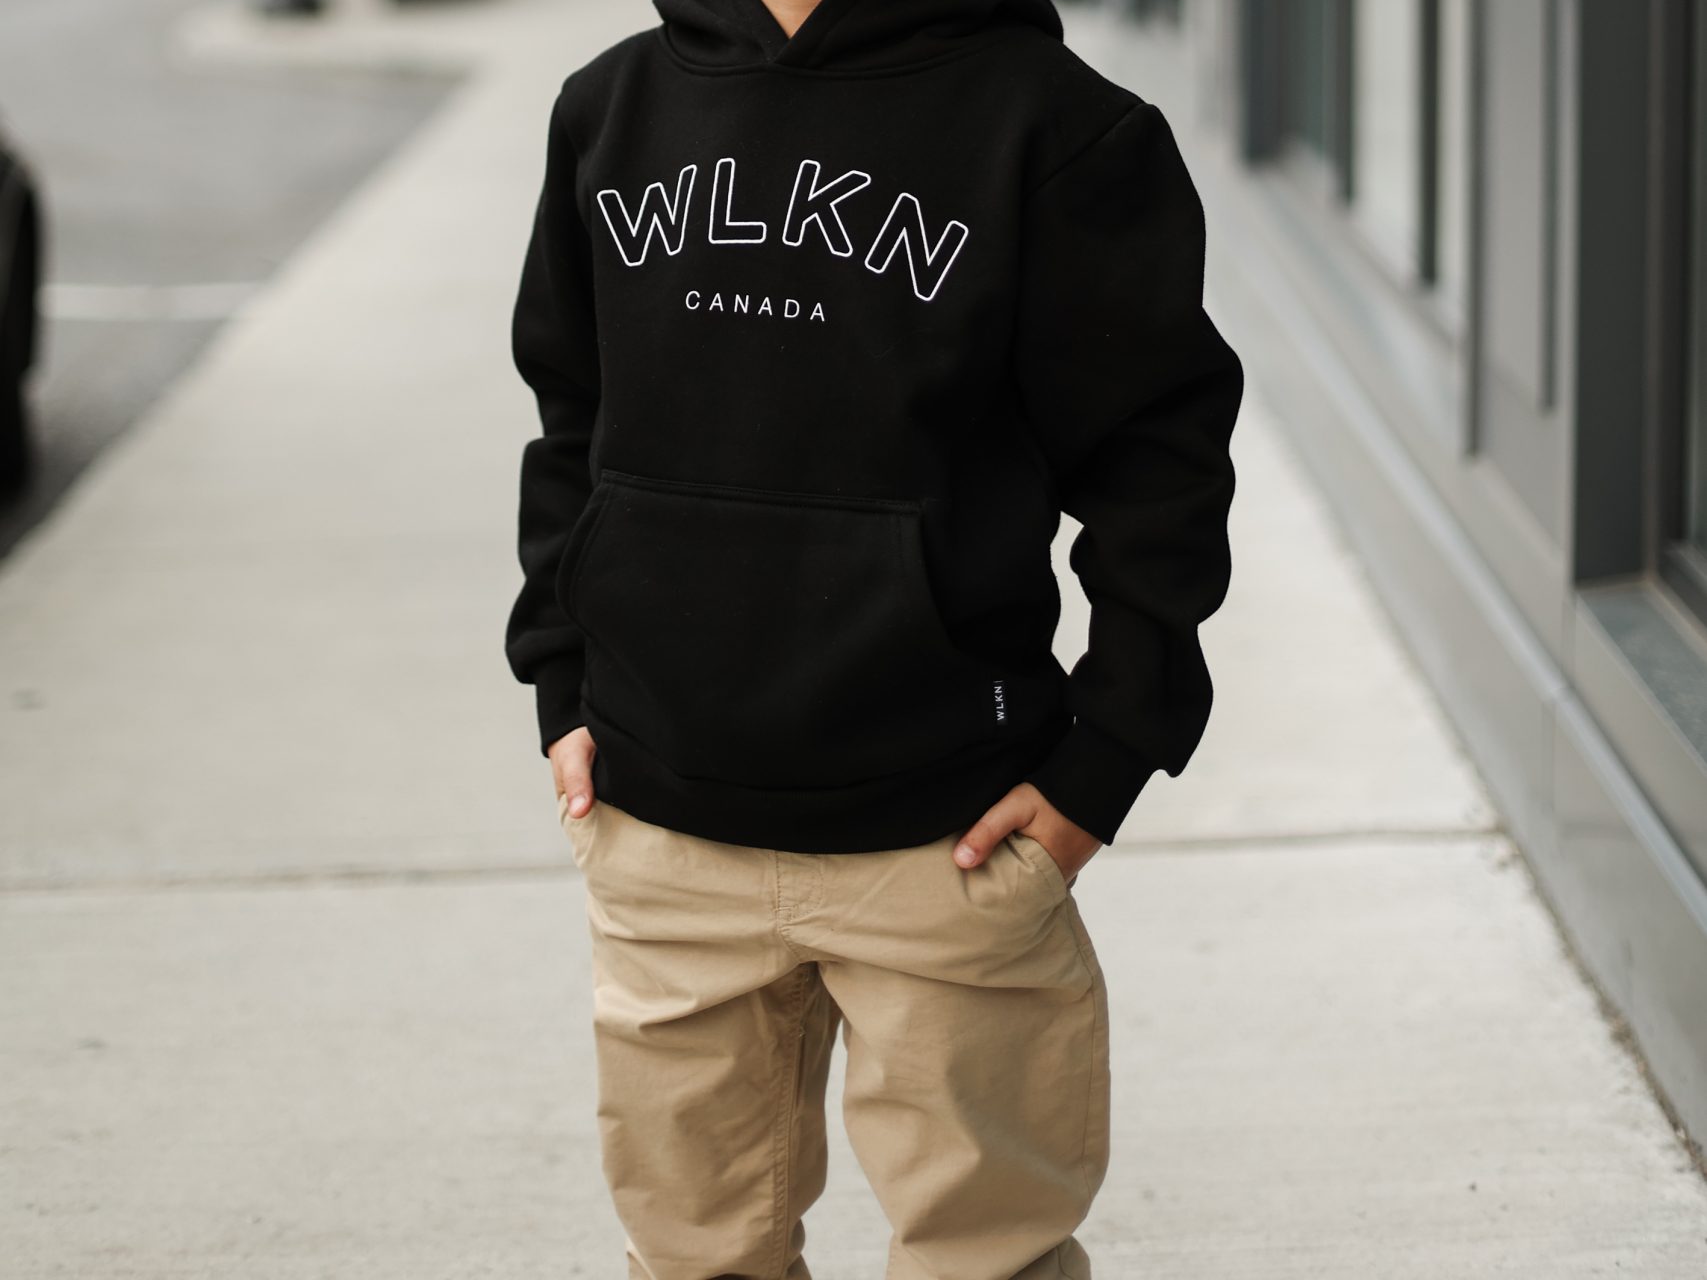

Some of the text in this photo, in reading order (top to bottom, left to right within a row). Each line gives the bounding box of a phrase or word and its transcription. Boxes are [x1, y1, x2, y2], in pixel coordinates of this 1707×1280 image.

[596, 157, 970, 302] WLKN
[685, 290, 826, 322] CANADA
[994, 685, 1005, 721] WLKN
